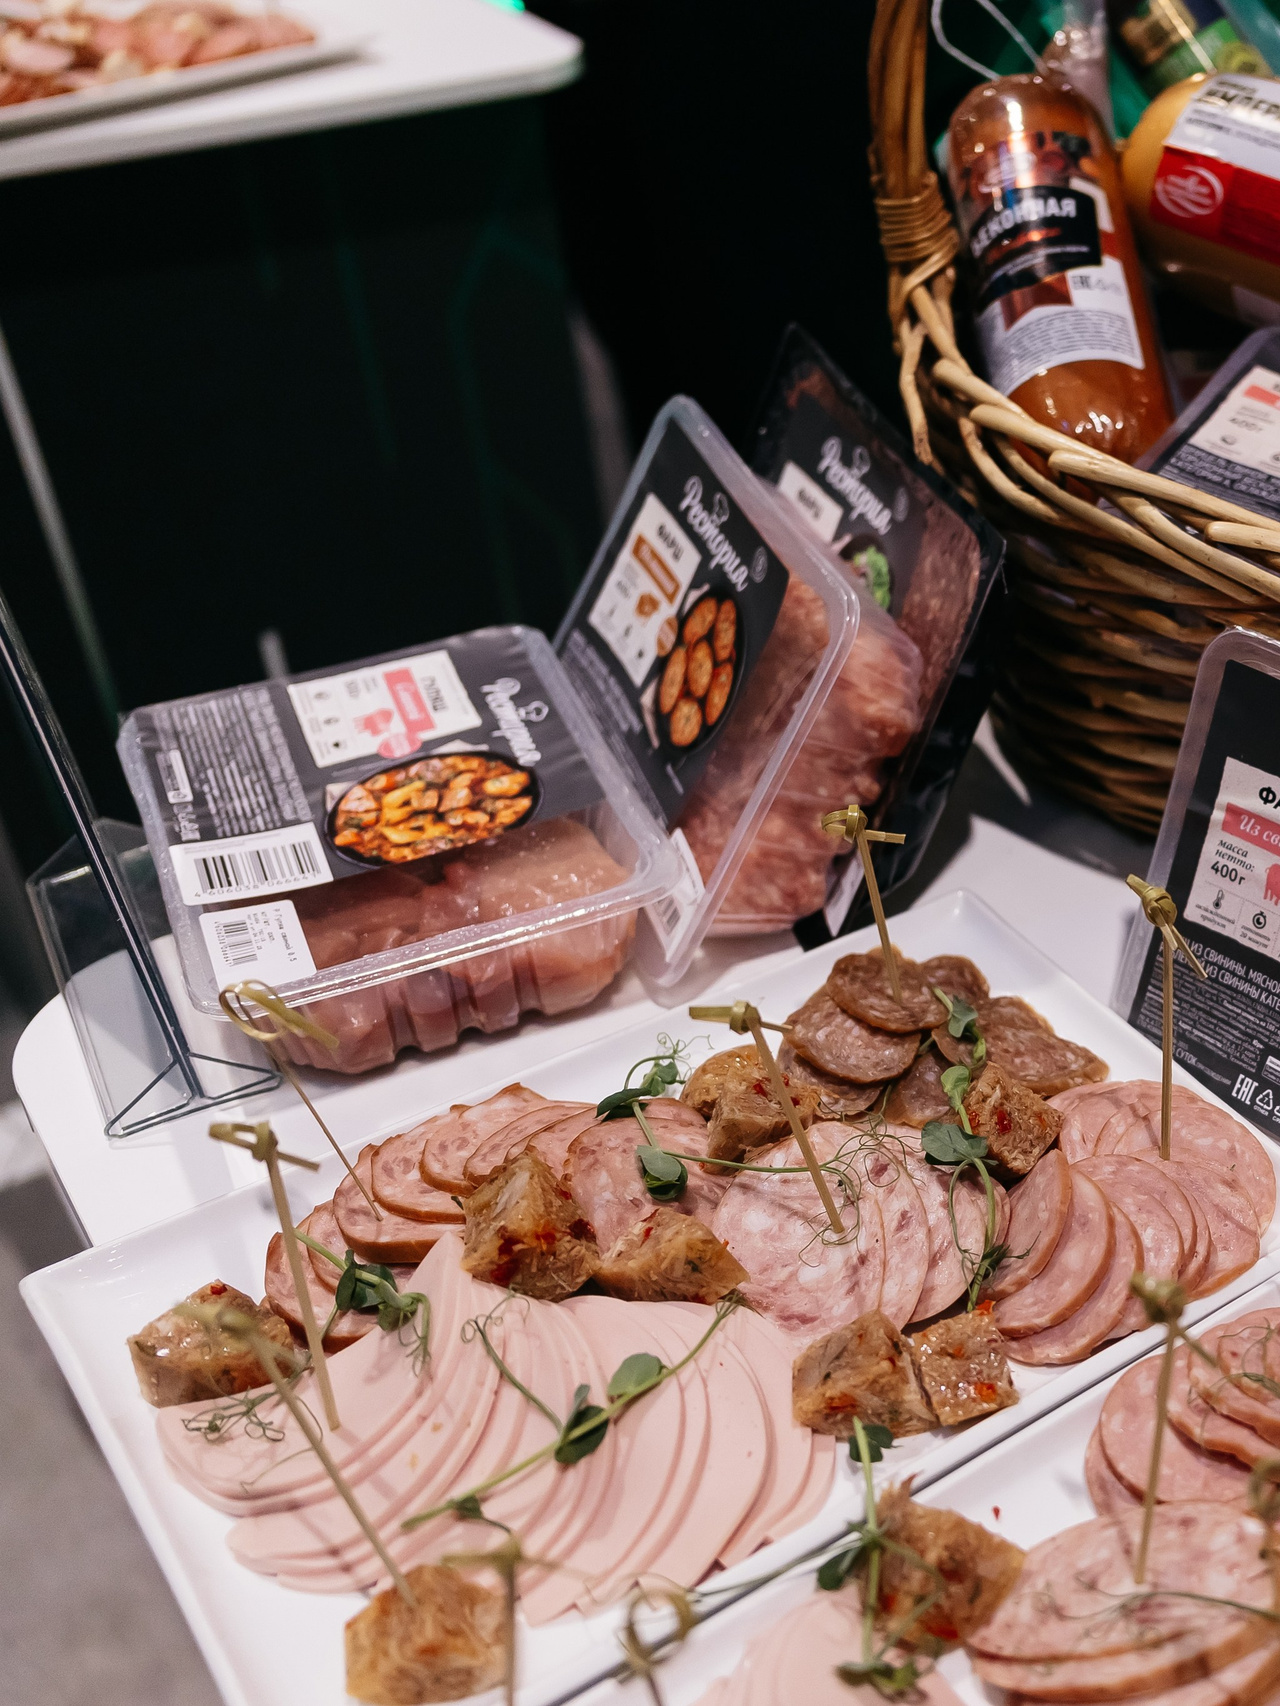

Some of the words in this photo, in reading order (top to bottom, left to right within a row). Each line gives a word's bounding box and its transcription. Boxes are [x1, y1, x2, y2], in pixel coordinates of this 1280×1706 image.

[1239, 814, 1260, 837] Из
[1217, 839, 1249, 858] масса
[1215, 849, 1256, 873] нетто:
[1191, 942, 1204, 956] ИЗ
[1203, 946, 1247, 977] СВИНИНЫ.
[1205, 964, 1217, 978] ИЗ
[1218, 969, 1260, 998] СВИНИНЫ
[1175, 1047, 1197, 1066] СУТОК
